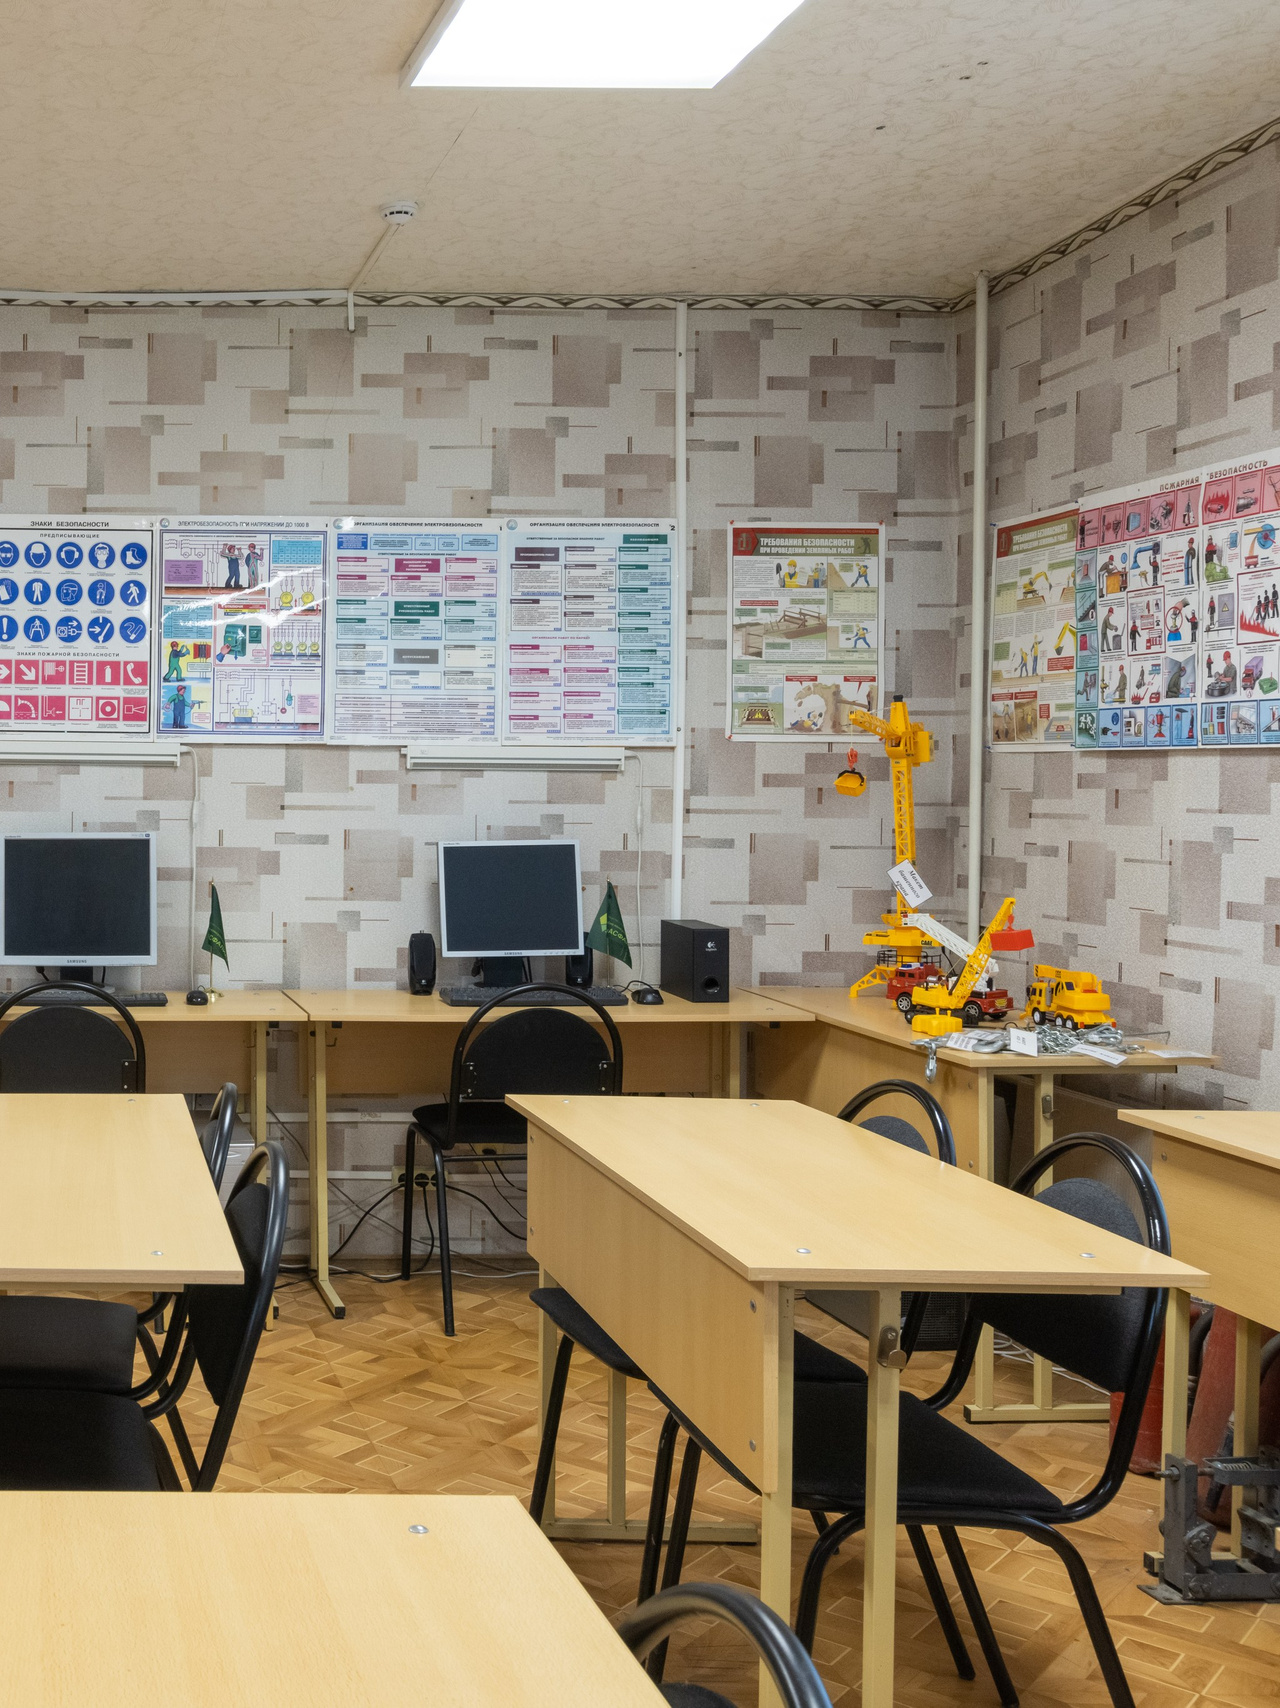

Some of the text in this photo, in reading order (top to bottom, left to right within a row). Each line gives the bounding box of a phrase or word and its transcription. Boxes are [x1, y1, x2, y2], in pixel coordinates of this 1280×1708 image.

[1160, 460, 1268, 492] ПОЖАРНАЯ БЕЗОПАСНОСТЬ
[760, 538, 802, 546] ТРЕБОВАНИЯ
[896, 880, 909, 896] крана
[908, 870, 923, 889] Макет
